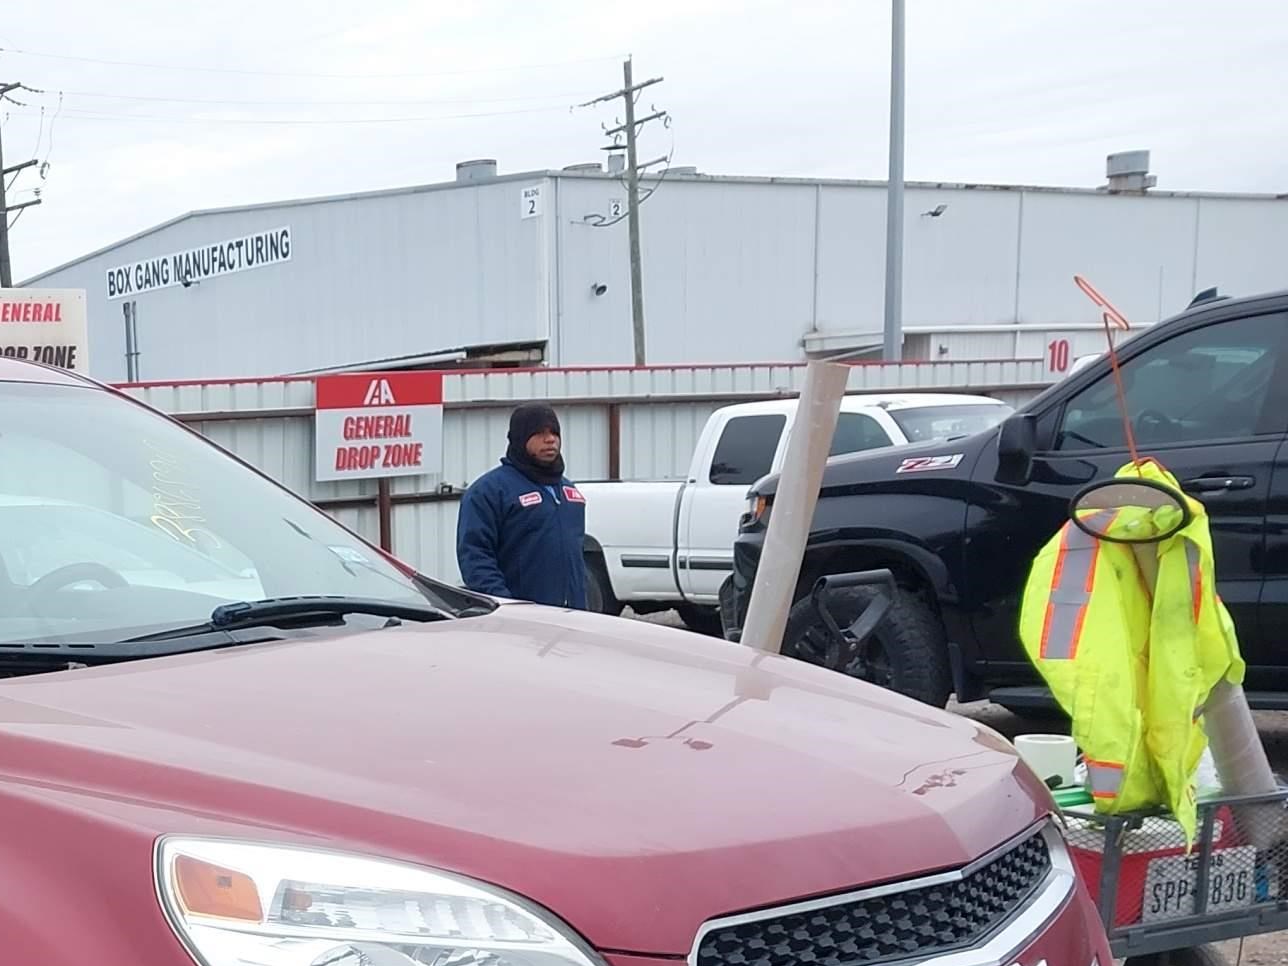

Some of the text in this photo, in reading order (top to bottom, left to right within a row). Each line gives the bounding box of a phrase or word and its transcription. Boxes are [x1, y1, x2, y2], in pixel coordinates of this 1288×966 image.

[528, 200, 536, 215] 2
[613, 204, 620, 216] 2
[108, 229, 290, 297] BOX GANG MANUFACTURING
[33, 346, 77, 369] ZONE
[1048, 339, 1070, 373] 10
[343, 414, 412, 440] GENERAL
[335, 443, 423, 471] DROP ZONE
